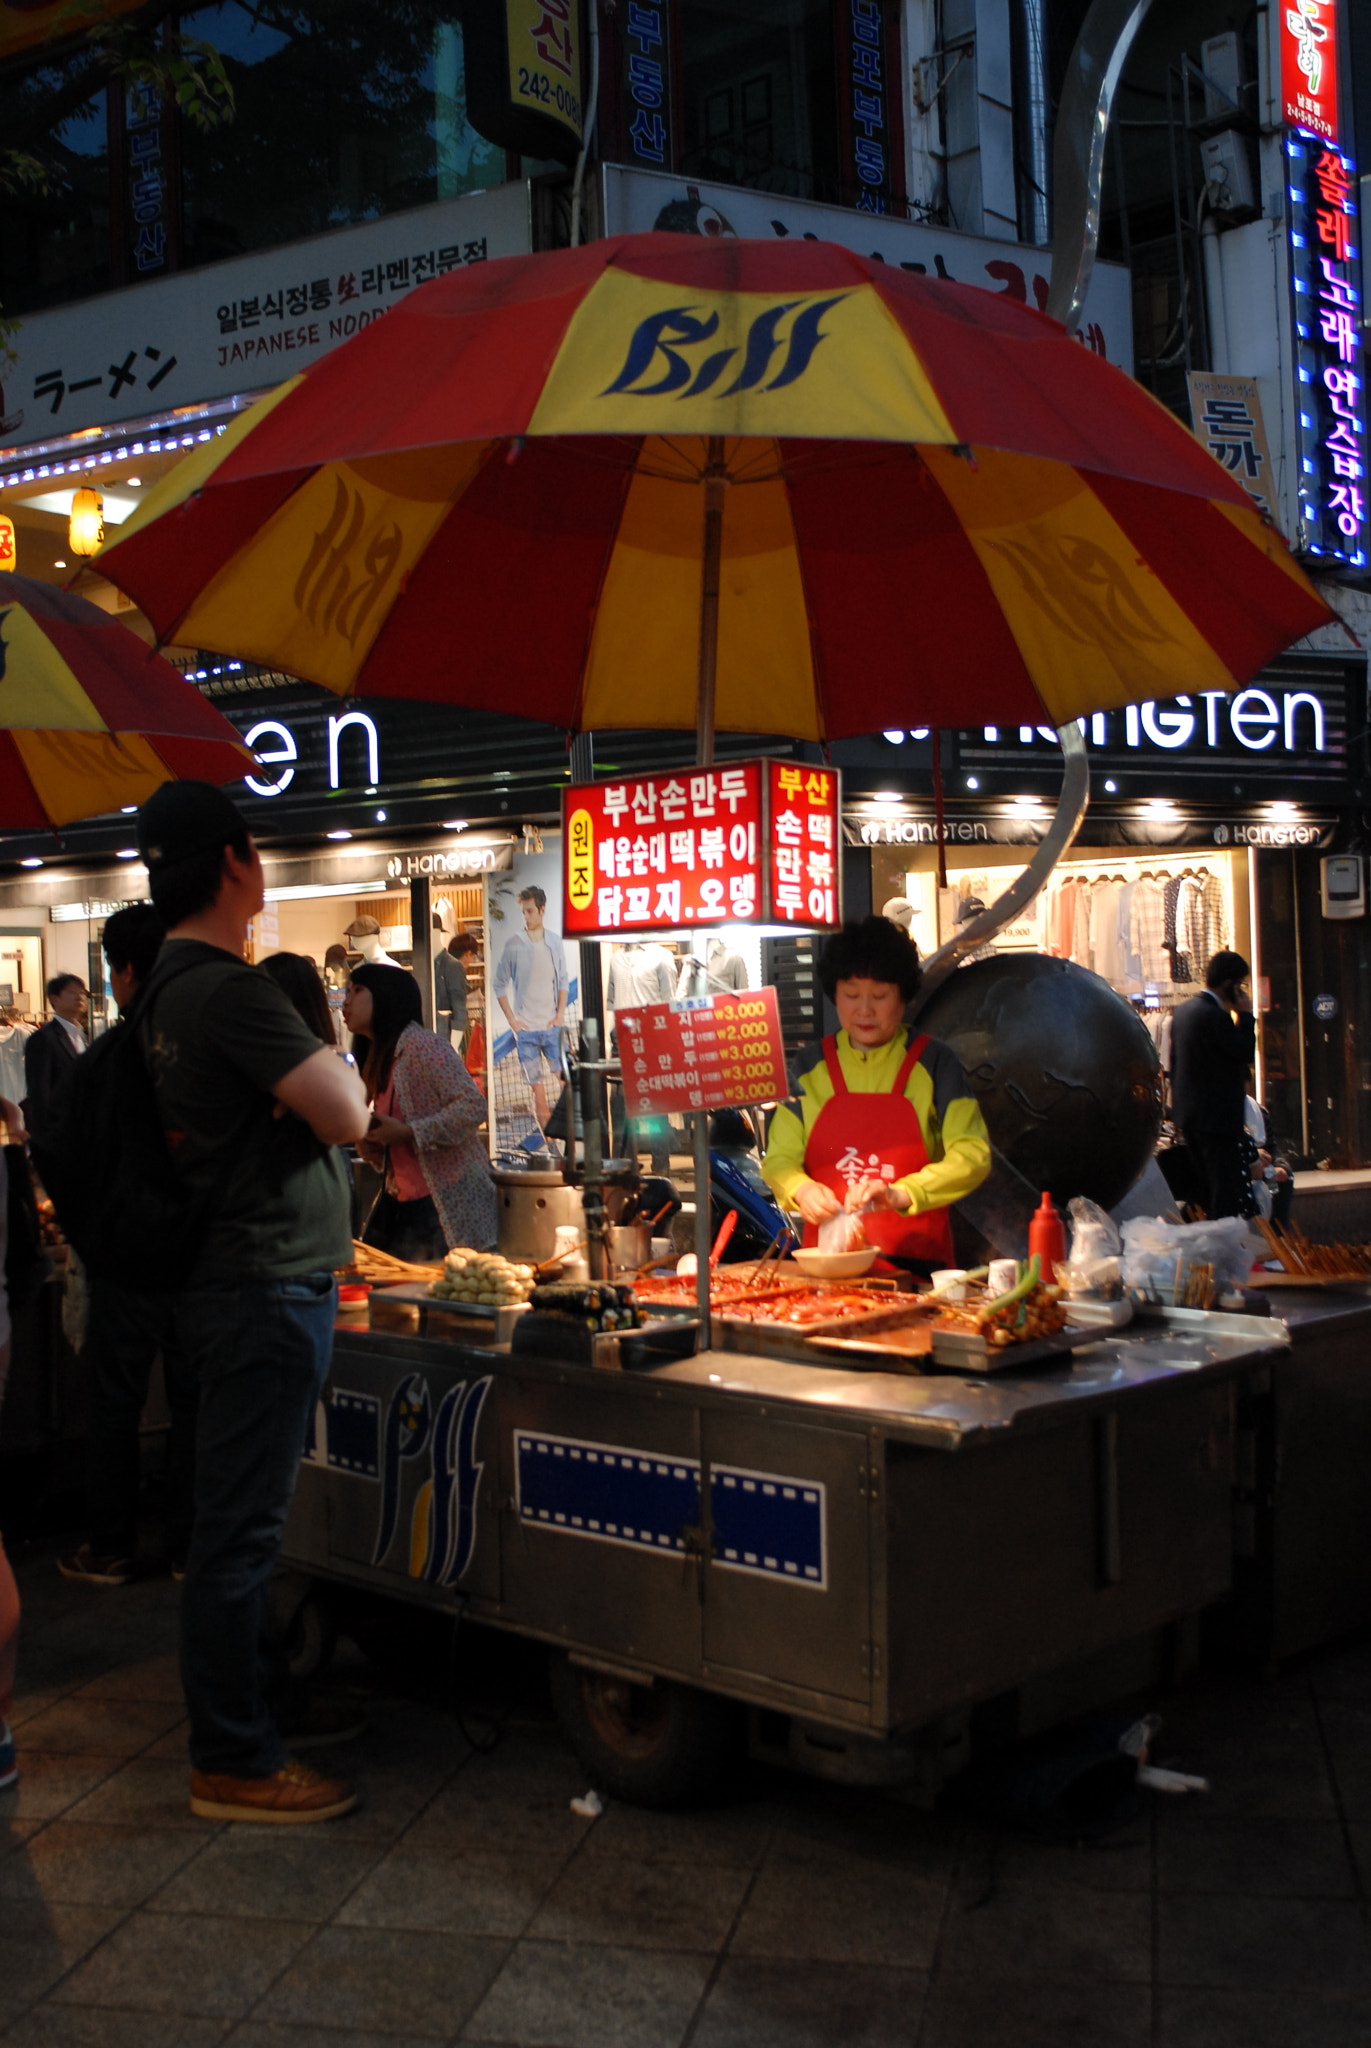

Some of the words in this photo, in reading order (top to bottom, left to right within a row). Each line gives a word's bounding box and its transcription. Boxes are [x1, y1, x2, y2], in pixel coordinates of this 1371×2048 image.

[627, 0, 667, 163] 부동산
[218, 323, 320, 367] JAPANESE
[329, 305, 394, 340] NOOD
[33, 346, 178, 415] ラーメン
[777, 766, 830, 807] 부산
[572, 819, 590, 898] 원조
[774, 808, 804, 921] 손만두
[806, 812, 834, 924] 떡볶이
